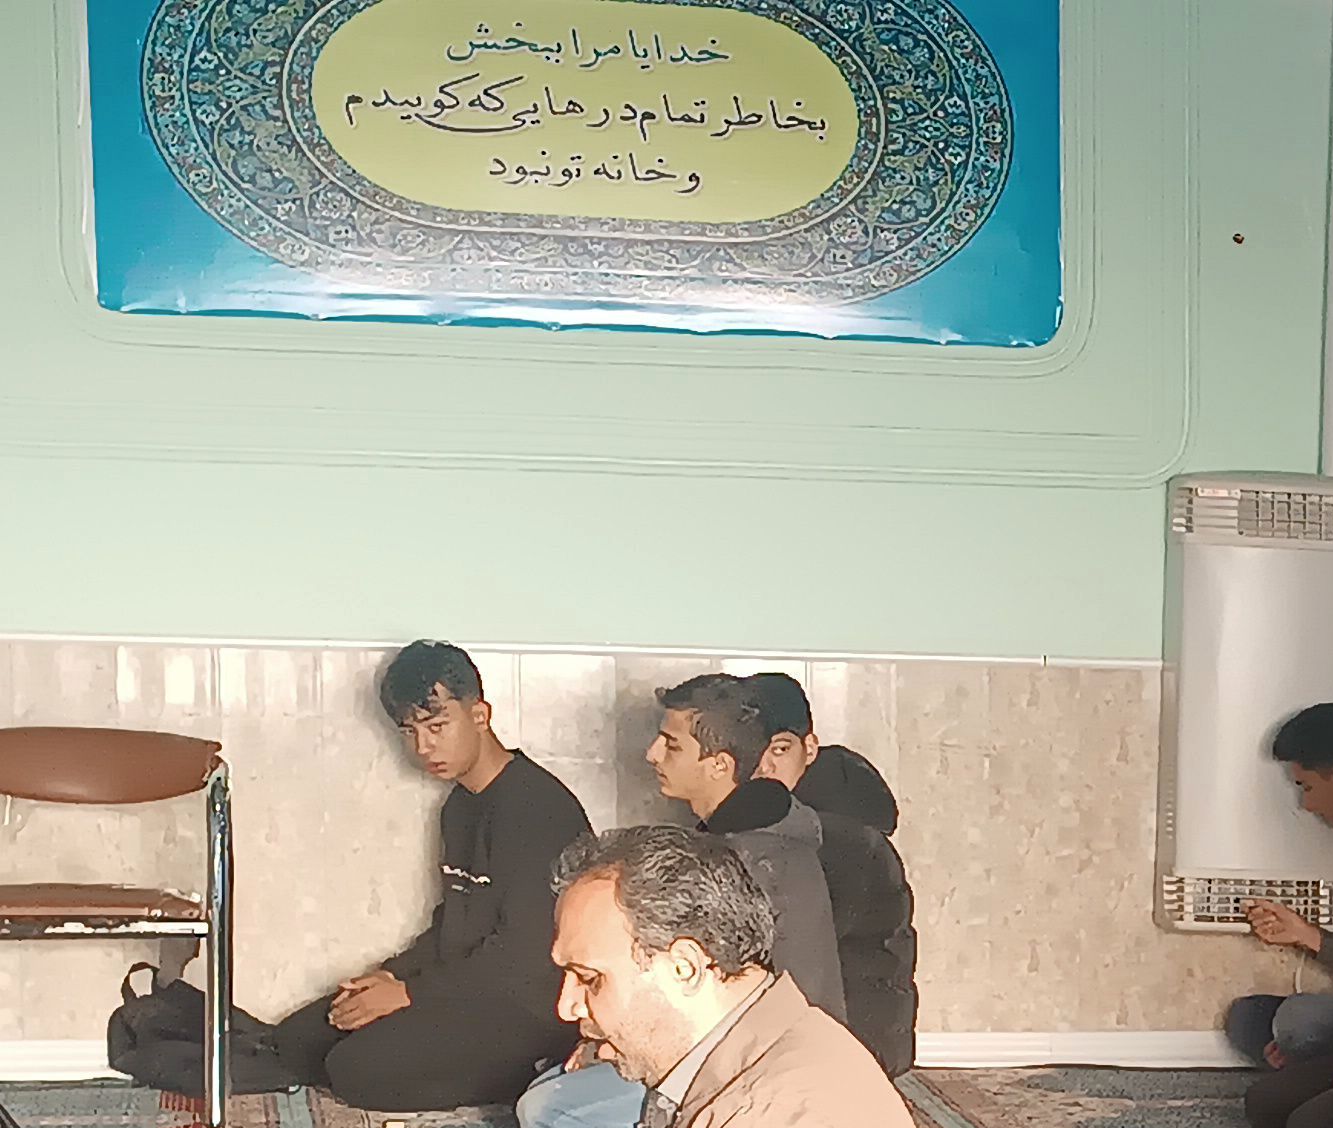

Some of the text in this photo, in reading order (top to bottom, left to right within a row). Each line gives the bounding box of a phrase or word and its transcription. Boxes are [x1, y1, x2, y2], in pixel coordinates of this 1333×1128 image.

[446, 22, 730, 70] خدایا مرا ببخش
[467, 75, 524, 112] که
[586, 103, 637, 128] در
[637, 94, 706, 142] تمام
[709, 95, 826, 141] بخاطر
[489, 150, 701, 194] و خانه تو نبود
